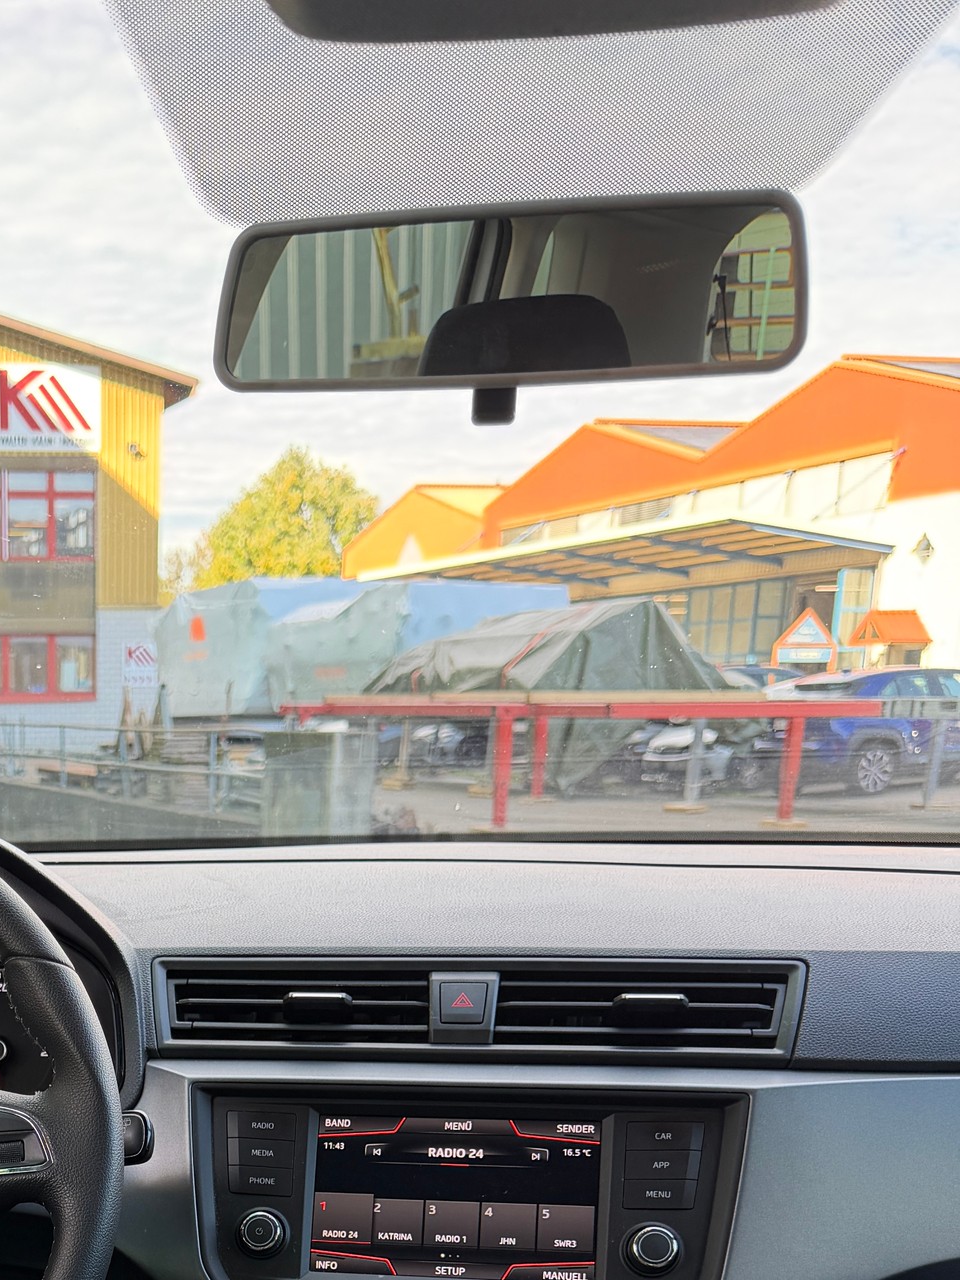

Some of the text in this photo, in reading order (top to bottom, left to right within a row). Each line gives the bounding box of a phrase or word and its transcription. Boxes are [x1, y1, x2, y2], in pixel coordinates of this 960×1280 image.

[251, 1121, 275, 1129] RADIO
[325, 1118, 351, 1128] BAND
[444, 1120, 472, 1131] MENÜ
[556, 1123, 595, 1134] SENDER
[654, 1132, 672, 1140] CAR
[323, 1141, 345, 1150] 11:43
[251, 1149, 274, 1157] MEDIA
[428, 1147, 484, 1159] RADIO 24
[563, 1148, 581, 1157] 16.5
[652, 1161, 670, 1169] APP
[249, 1177, 276, 1185] PHONE
[645, 1190, 671, 1198] MENU
[320, 1201, 326, 1211] 1
[373, 1203, 381, 1213] 2
[428, 1204, 436, 1215] 3
[484, 1207, 493, 1217] 4
[542, 1209, 550, 1219] 5
[322, 1230, 359, 1239] RADIO 24
[378, 1232, 413, 1241] KATRINA
[435, 1235, 460, 1243] RADIO
[553, 1239, 577, 1248] SWR3
[315, 1260, 338, 1270] INFO
[435, 1266, 466, 1276] SETUP
